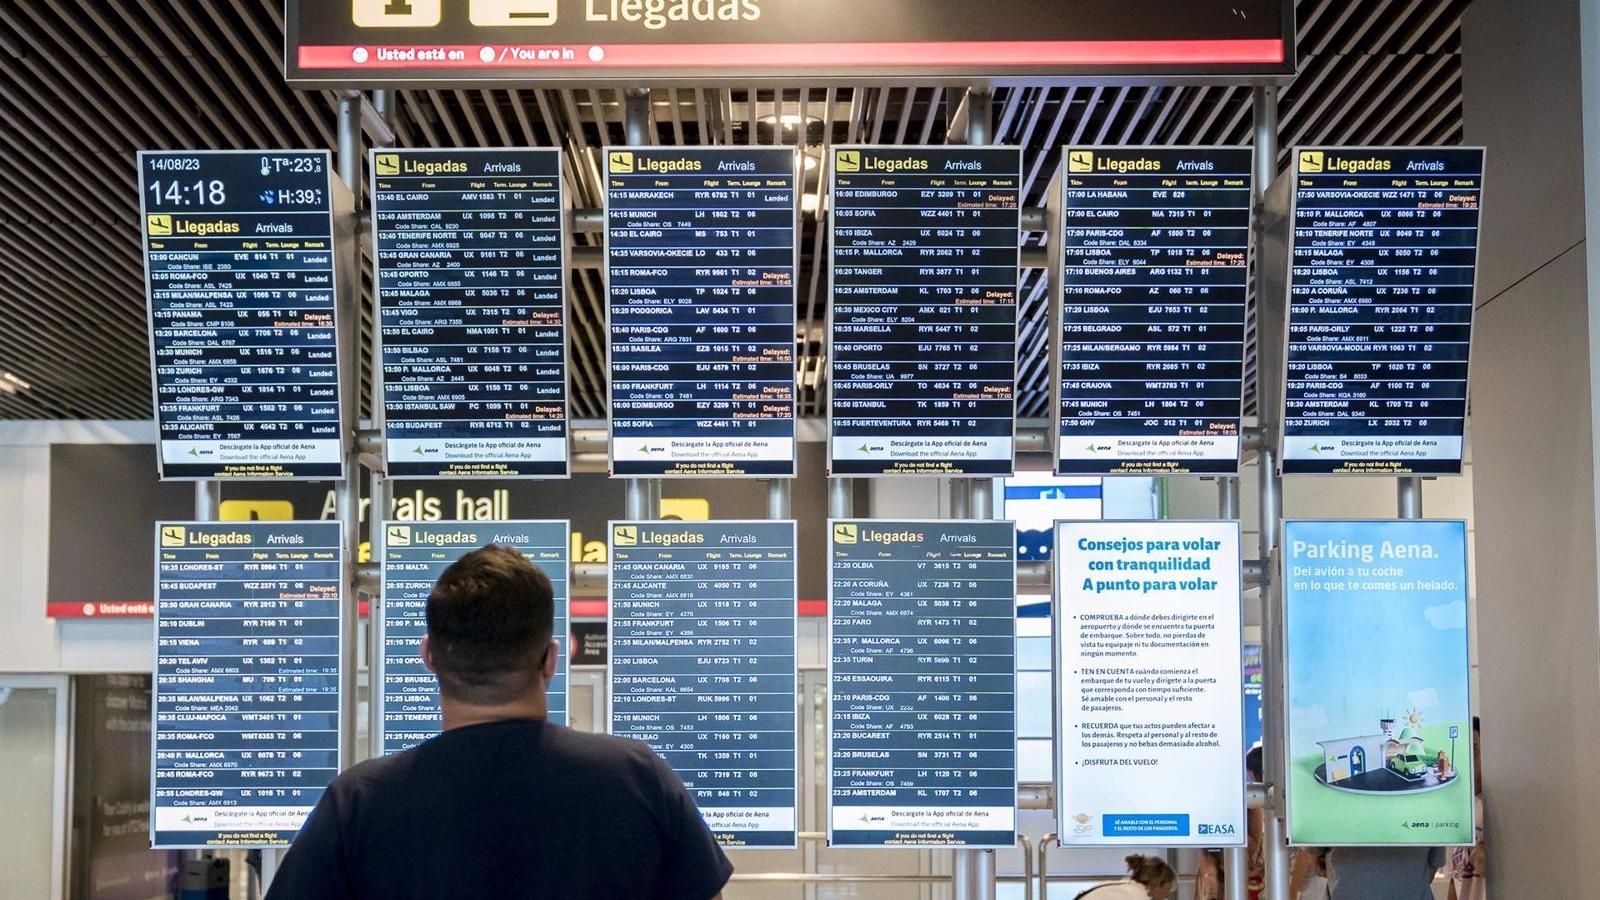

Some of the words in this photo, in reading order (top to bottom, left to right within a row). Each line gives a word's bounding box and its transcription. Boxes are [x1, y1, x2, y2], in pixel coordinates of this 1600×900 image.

[585, 0, 761, 30] Llegadas
[377, 48, 415, 61] Usted
[418, 47, 445, 61] está
[448, 50, 464, 61] en
[511, 48, 534, 61] You
[538, 50, 559, 61] are
[563, 48, 574, 61] in
[149, 159, 200, 170] 14/08/23
[404, 160, 468, 174] Llegadas
[484, 163, 521, 172] Arrivals
[638, 158, 701, 173] Llegadas
[718, 161, 755, 171] Arrivals
[865, 157, 928, 172] Llegadas
[945, 160, 982, 170] Arrivals
[1097, 158, 1160, 172] Llegadas
[1177, 160, 1213, 170] Arrivals
[1327, 158, 1391, 172] Llegadas
[1407, 161, 1444, 171] Arrivals
[150, 180, 225, 205] 14:18
[176, 221, 240, 235] Llegadas
[256, 223, 293, 233] Arrivals
[456, 489, 509, 521] hall
[189, 532, 252, 547] Llegadas
[267, 534, 304, 544] Arrivals
[415, 532, 477, 546] Llegadas
[493, 534, 529, 543] Arrivals
[642, 531, 704, 546] Llegadas
[720, 534, 757, 543] Arrivals
[862, 530, 924, 545] Llegadas
[940, 534, 977, 543] Arrivals
[1078, 538, 1143, 553] Consejos
[1146, 540, 1180, 553] para
[1183, 537, 1220, 551] volar
[1293, 540, 1373, 563] Parking
[1380, 540, 1439, 559] Aena.
[1088, 560, 1113, 570] con
[1117, 557, 1211, 574] tranquilidad
[1294, 567, 1311, 576] Del
[1314, 566, 1344, 576] avión
[1358, 568, 1369, 576] tu
[1372, 567, 1404, 576] coche
[1082, 578, 1093, 590] A
[1097, 579, 1140, 593] punto
[1144, 580, 1176, 593] para
[1180, 578, 1218, 590] volar
[1311, 581, 1321, 590] lo
[1324, 583, 1344, 593] que
[1348, 582, 1359, 590] te
[1417, 581, 1458, 590] helado.
[1171, 614, 1198, 622] dirigirte
[1089, 632, 1124, 640] embarque.
[1173, 632, 1196, 640] pierdas
[1105, 641, 1134, 650] equipaje
[1080, 650, 1104, 658] ningún
[1162, 723, 1187, 731] pueden
[1116, 732, 1143, 740] Respeta
[1151, 732, 1179, 740] personal
[1092, 741, 1123, 749] pasajeros
[1082, 759, 1118, 767] ¡DISFRUTA
[1208, 824, 1235, 834] EASA
[1435, 821, 1460, 829] parking
